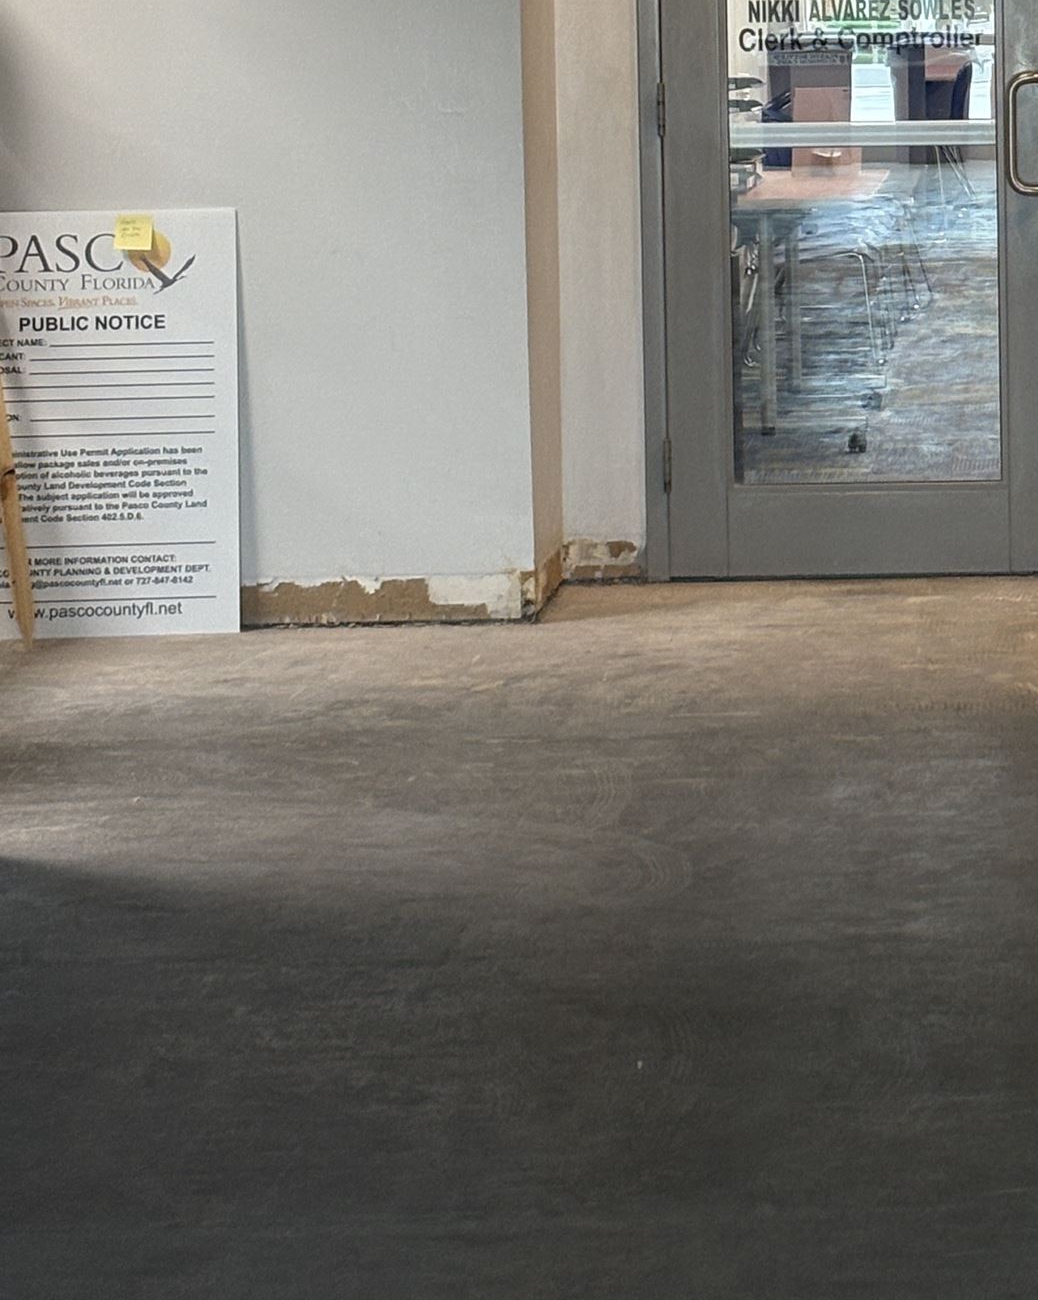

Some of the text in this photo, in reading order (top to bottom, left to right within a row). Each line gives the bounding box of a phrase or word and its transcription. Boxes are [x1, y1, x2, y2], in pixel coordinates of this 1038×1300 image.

[748, 0, 800, 23] NIKKI
[738, 26, 983, 55] Clerk & Comptroller
[81, 274, 156, 291] FLORIDA
[19, 314, 166, 332] PUBLIC NOTICE
[61, 449, 78, 457] Use
[80, 448, 109, 457] Permit
[111, 447, 160, 457] Application
[163, 446, 179, 455] has
[181, 446, 203, 454] been
[38, 461, 75, 470] package
[77, 459, 100, 468] sales
[40, 471, 49, 479] of
[51, 470, 91, 479] alcoholic
[93, 469, 139, 479] beverages
[141, 468, 181, 478] pursuant
[194, 467, 208, 475] the
[44, 482, 66, 490] Land
[68, 480, 126, 490] Development
[128, 480, 151, 488] Code
[153, 479, 187, 487] Section
[37, 493, 69, 502] subject
[71, 491, 120, 501] application
[122, 490, 137, 499] will
[152, 489, 194, 499] approved
[52, 503, 92, 513] pursuant
[122, 501, 149, 510] Pasco
[151, 500, 183, 510] County
[185, 499, 208, 508] Land
[40, 515, 63, 523] Code
[66, 513, 99, 522] Section
[35, 558, 62, 566] MORE
[64, 556, 129, 565] INFORMATION
[53, 567, 102, 577] PLANNING
[104, 567, 111, 575] &
[113, 565, 182, 575] DEVELOPMENT
